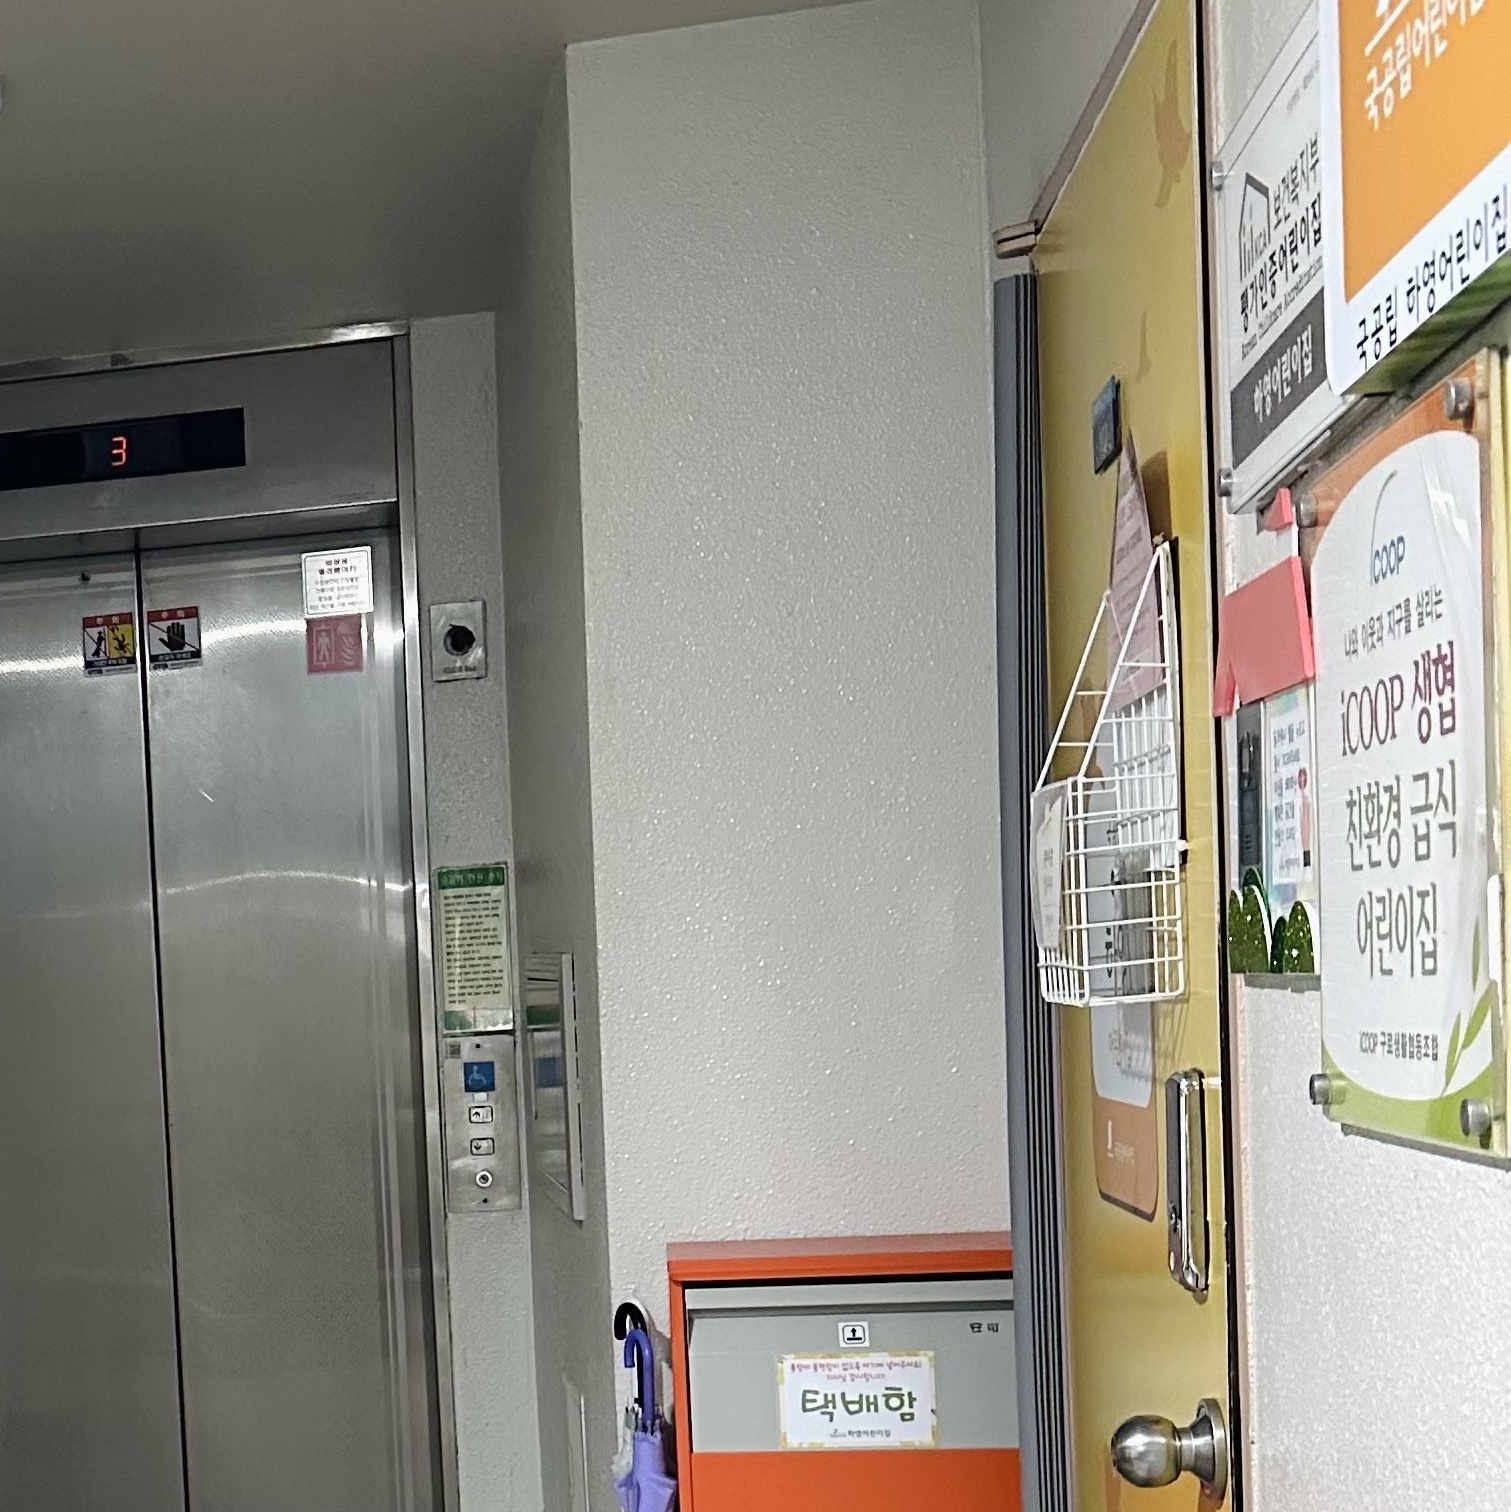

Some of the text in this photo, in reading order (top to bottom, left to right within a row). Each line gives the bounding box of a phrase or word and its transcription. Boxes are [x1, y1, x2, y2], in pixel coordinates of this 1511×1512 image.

[1364, 0, 1486, 132] 국공립어린
[1274, 131, 1320, 230] 보건복지부
[1241, 191, 1322, 334] 평가인증어린이집
[1356, 184, 1508, 371] 국공립 하영어린이집
[111, 436, 127, 467] 3
[1387, 597, 1413, 640] 지구를
[1416, 583, 1444, 628] 살리는
[1341, 640, 1456, 757] iCOOP 생협
[1346, 775, 1402, 871] 친환경
[1410, 760, 1458, 860] 급식
[1356, 882, 1439, 978] 어린이집
[801, 1386, 917, 1422] 택배함
